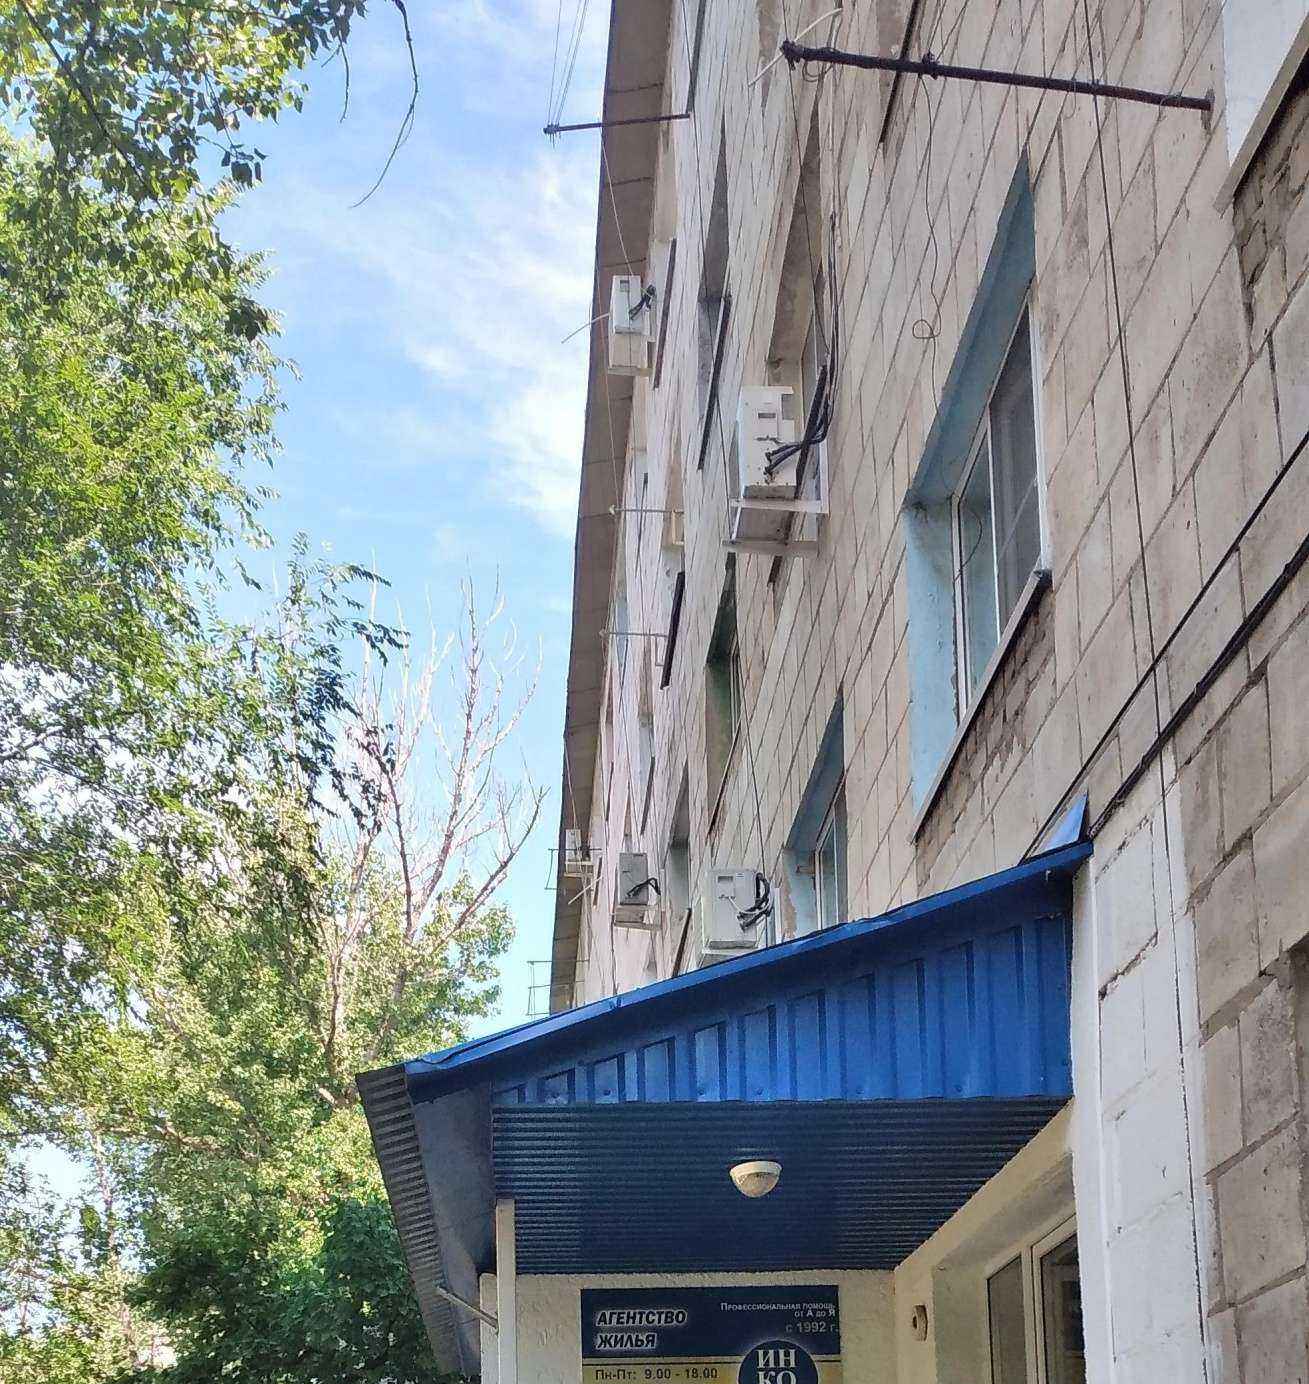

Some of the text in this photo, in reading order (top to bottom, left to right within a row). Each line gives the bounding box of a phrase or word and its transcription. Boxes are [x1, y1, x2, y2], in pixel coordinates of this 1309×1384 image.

[595, 1308, 688, 1327] АГЕНТСТВО
[828, 1309, 836, 1317] Я
[797, 1321, 826, 1333] 1992
[830, 1323, 839, 1332] г.
[595, 1332, 657, 1350] ЖИЛЬЯ
[757, 1349, 796, 1369] ИН
[595, 1369, 637, 1380] Пн-Пт:
[644, 1369, 671, 1380] 9.00
[685, 1367, 718, 1379] 18.00
